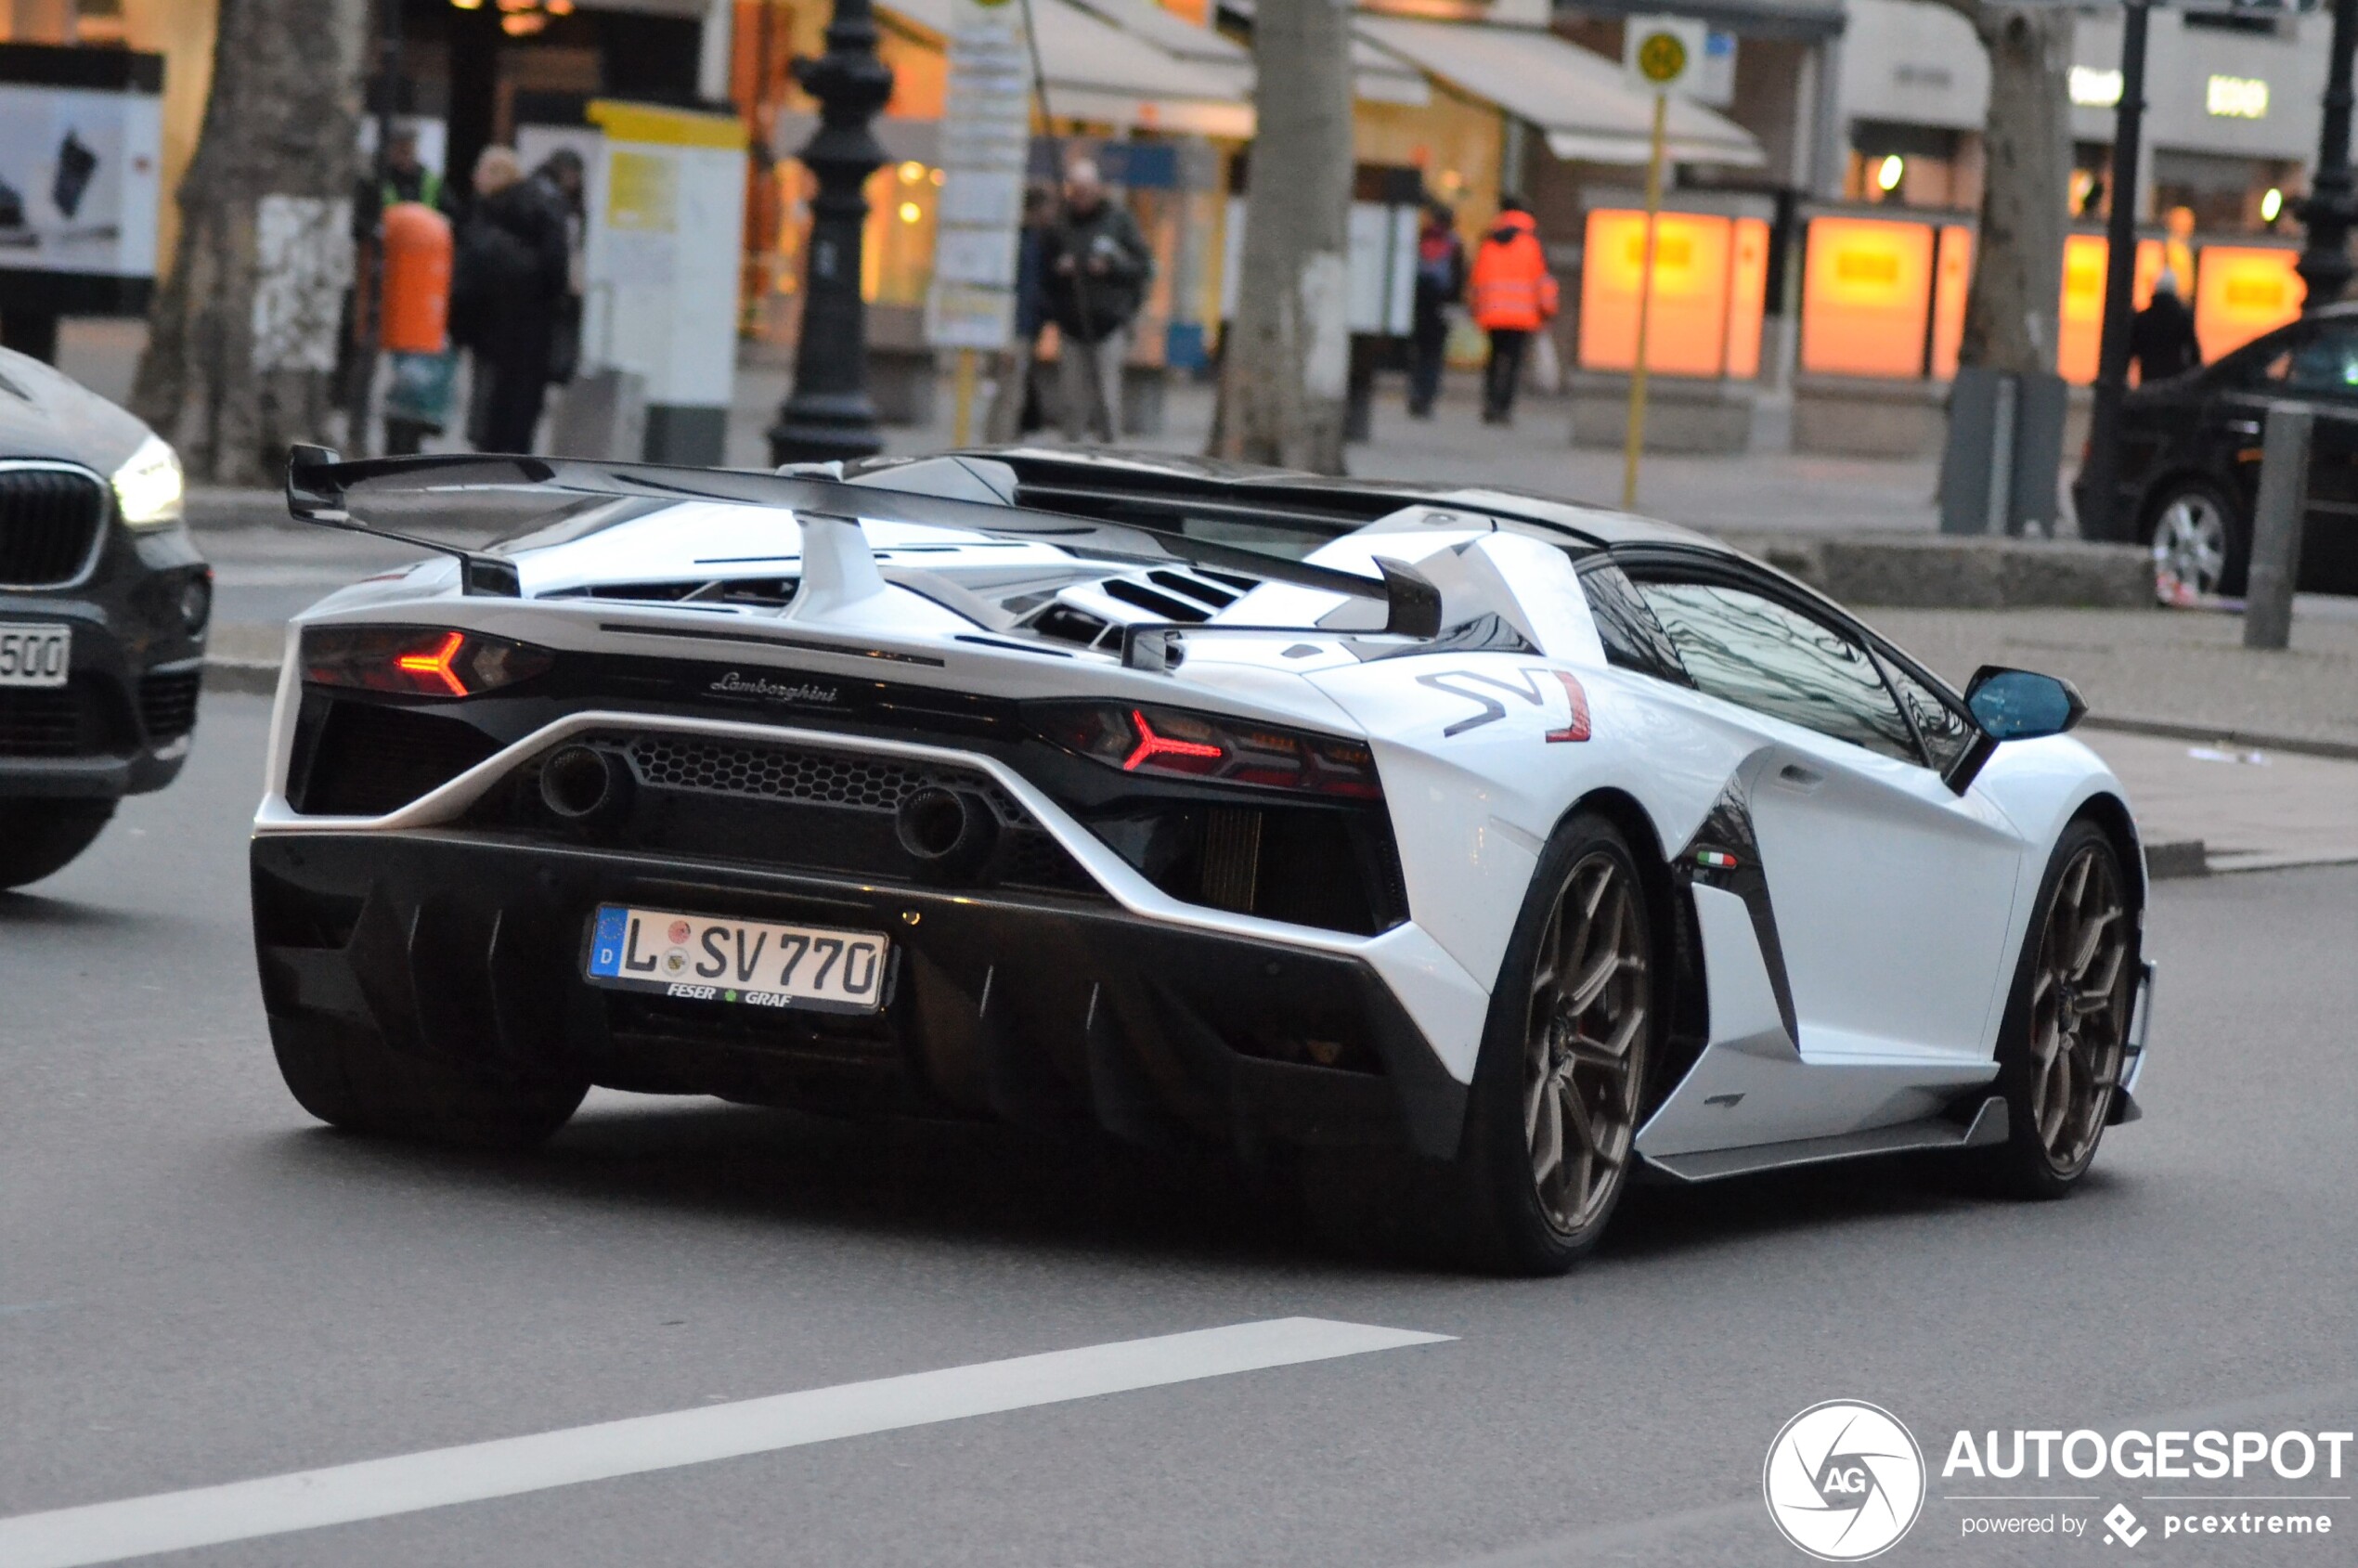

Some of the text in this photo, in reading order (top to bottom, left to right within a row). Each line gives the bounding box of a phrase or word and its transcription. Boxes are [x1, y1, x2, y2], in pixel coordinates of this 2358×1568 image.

[710, 671, 837, 702] Lamborghini
[600, 949, 613, 965] D
[625, 918, 877, 994] L SV 770
[667, 983, 791, 1008] FESER GRAF
